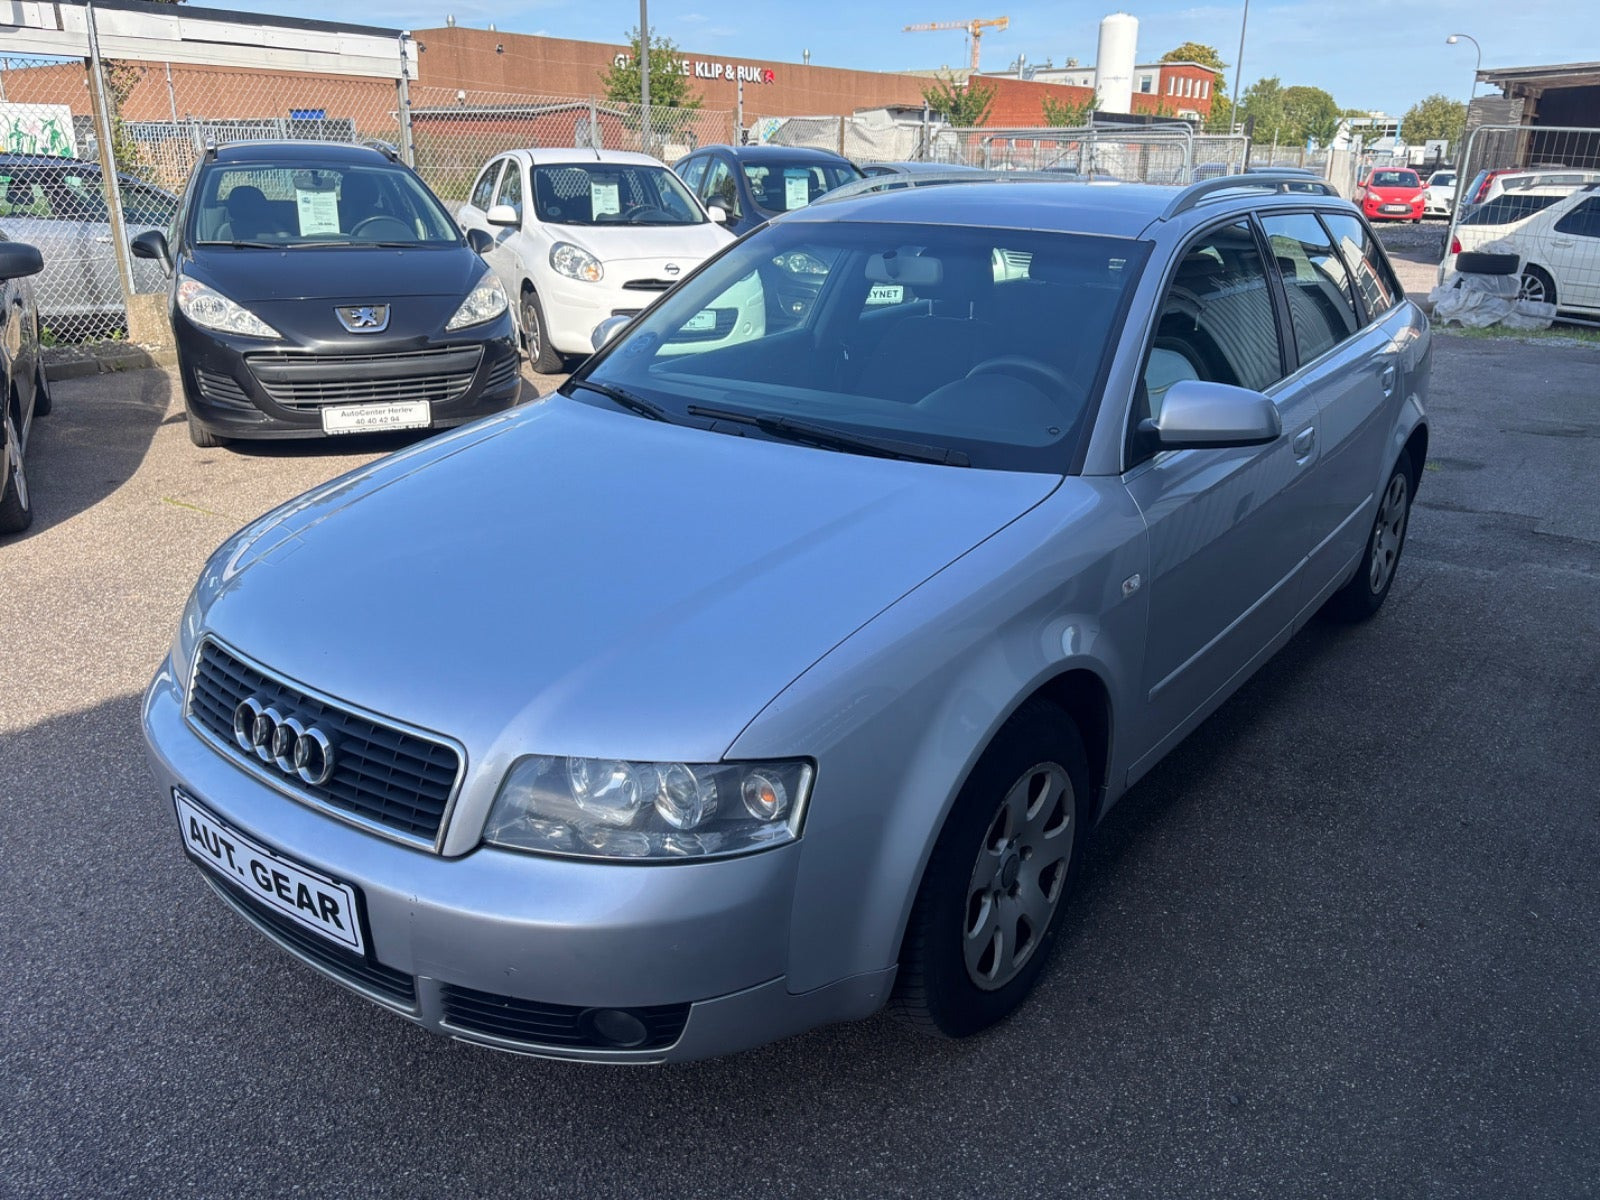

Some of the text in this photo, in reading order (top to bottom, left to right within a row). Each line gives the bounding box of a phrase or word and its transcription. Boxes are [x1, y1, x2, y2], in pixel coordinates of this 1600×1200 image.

[695, 61, 723, 78] KLIP
[725, 64, 735, 80] &
[341, 406, 414, 417] AutoCenter Herlev
[190, 816, 346, 931] AUT. GEAR
